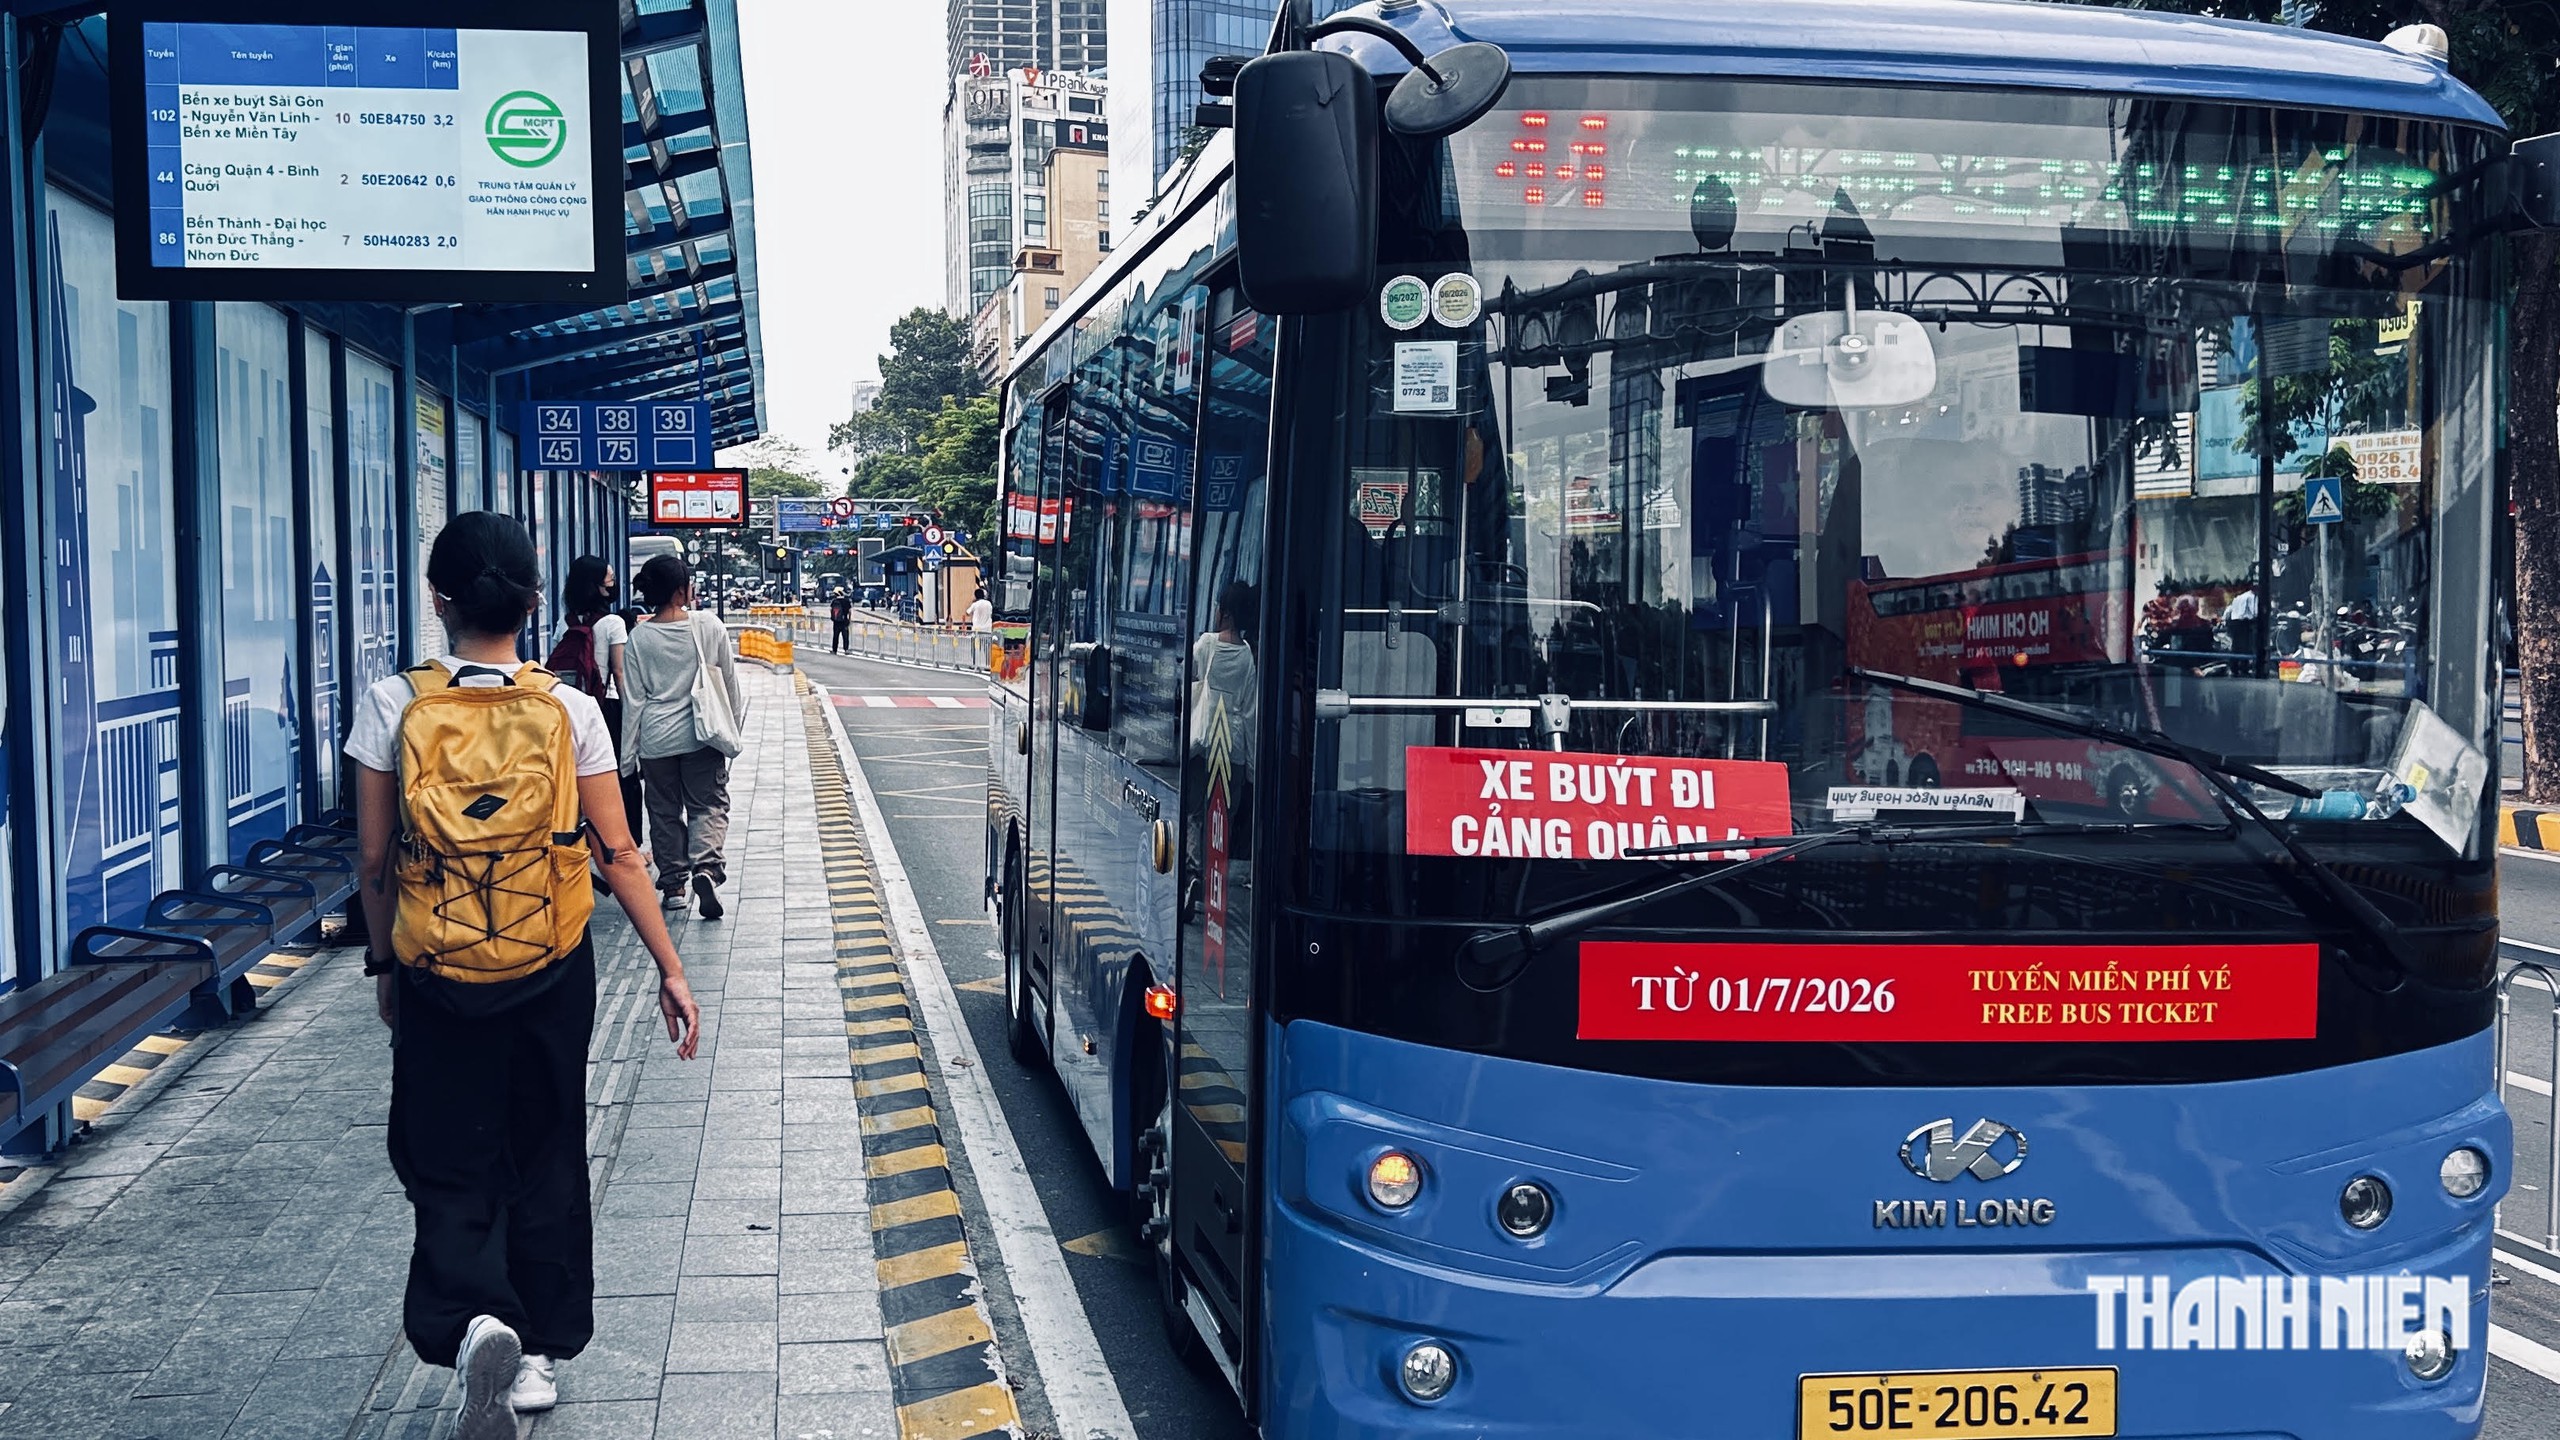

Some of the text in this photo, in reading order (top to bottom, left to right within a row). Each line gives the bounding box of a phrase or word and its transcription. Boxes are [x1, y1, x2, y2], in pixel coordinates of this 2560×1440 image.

[385, 54, 396, 62] Xe
[427, 51, 456, 60] K/cách
[432, 61, 451, 69] (km)
[182, 91, 324, 110] Bến xe buýt Sài Gòn
[151, 109, 176, 122] 102
[191, 109, 245, 124] Nguyễn
[249, 111, 276, 123] Văn
[280, 111, 310, 123] Linh
[336, 112, 350, 124] 10
[360, 113, 426, 125] 50E84750
[434, 114, 454, 128] 3,2
[523, 118, 555, 127] MCPT
[183, 124, 297, 142] Bến xe Miền Tây
[157, 171, 175, 183] 44
[184, 163, 221, 178] Cảng
[225, 164, 262, 178] Quận
[266, 164, 275, 176] 4
[287, 165, 319, 177] Bình
[184, 179, 220, 192] Quới
[340, 173, 349, 185] 2
[361, 174, 428, 186] 50E20642
[435, 175, 456, 188] 0,6
[478, 181, 577, 191] TRUNG TÂM QUẢN LÝ
[468, 194, 587, 206] GIAO THÔNG CÔNG CỘNG
[507, 208, 531, 217] HẠNH
[532, 209, 557, 218] PHỤC
[558, 209, 570, 218] VỤ
[186, 214, 213, 229] Bến
[217, 217, 261, 229] Thành
[274, 217, 297, 232] Đại
[301, 218, 327, 233] học
[159, 233, 176, 245] 86
[187, 232, 213, 245] Tôn
[217, 232, 247, 245] Đức
[342, 234, 350, 246] 7
[363, 235, 430, 247] 50H40283
[437, 236, 457, 249] 2,0
[187, 249, 260, 261] Nhơn Đức
[1402, 387, 1426, 397] 07/32
[545, 409, 573, 431] 34
[604, 409, 631, 430] 38
[660, 408, 687, 430] 39
[546, 440, 573, 462] 45
[606, 440, 632, 461] 75
[1478, 757, 1716, 810] XE BUÝT ĐI
[1832, 790, 1994, 811] Nguyễn Ngọc Hoàng Anh
[1451, 803, 1573, 858] CẢNG
[1968, 960, 2231, 992] TUYẾN MIỄN PHÍ VÉ
[1632, 965, 1896, 1013] TỪ 01/7/2026
[1981, 1002, 2218, 1024] FREE BUS TICKET
[1873, 1197, 2057, 1229] KIM LONG
[1828, 1382, 2090, 1432] 50E-206.42
